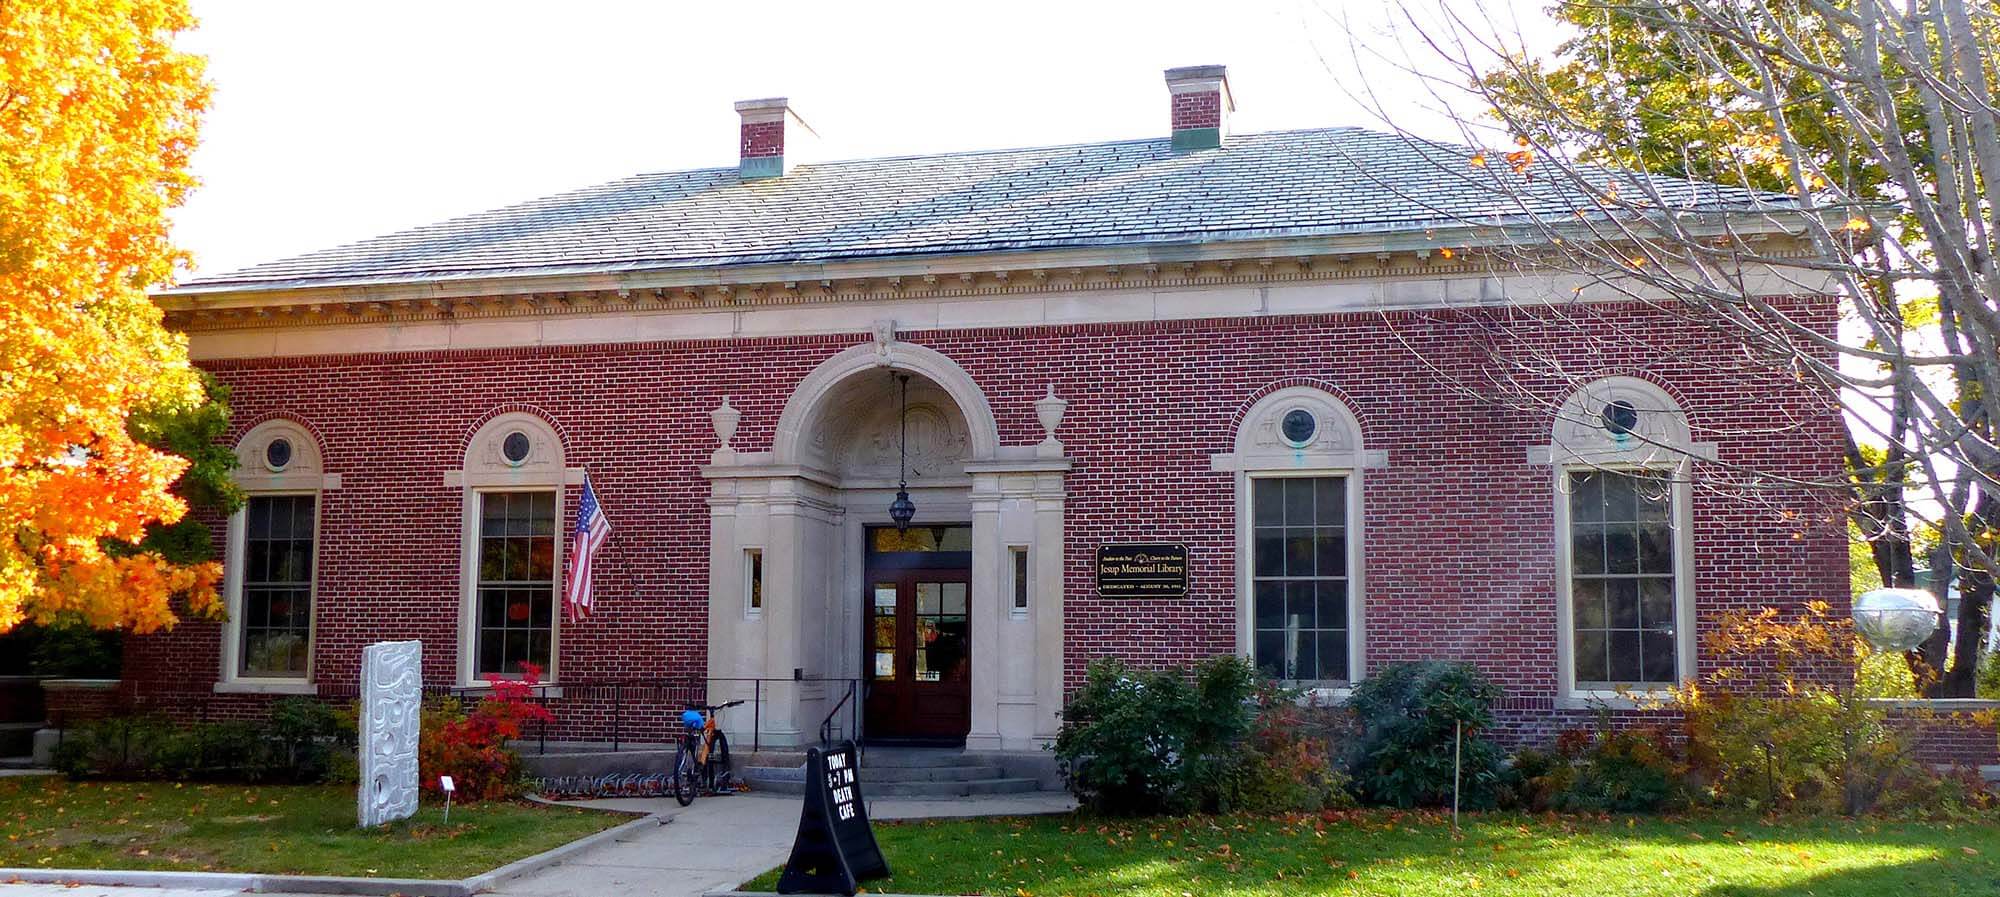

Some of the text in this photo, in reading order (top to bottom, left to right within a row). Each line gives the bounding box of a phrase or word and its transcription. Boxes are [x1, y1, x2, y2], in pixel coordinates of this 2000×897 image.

[1101, 562, 1184, 576] Jesup Memorial Library
[827, 753, 846, 770] TODAY
[844, 768, 854, 784] PM
[833, 786, 853, 805] DEATH
[839, 802, 855, 820] CAFE
